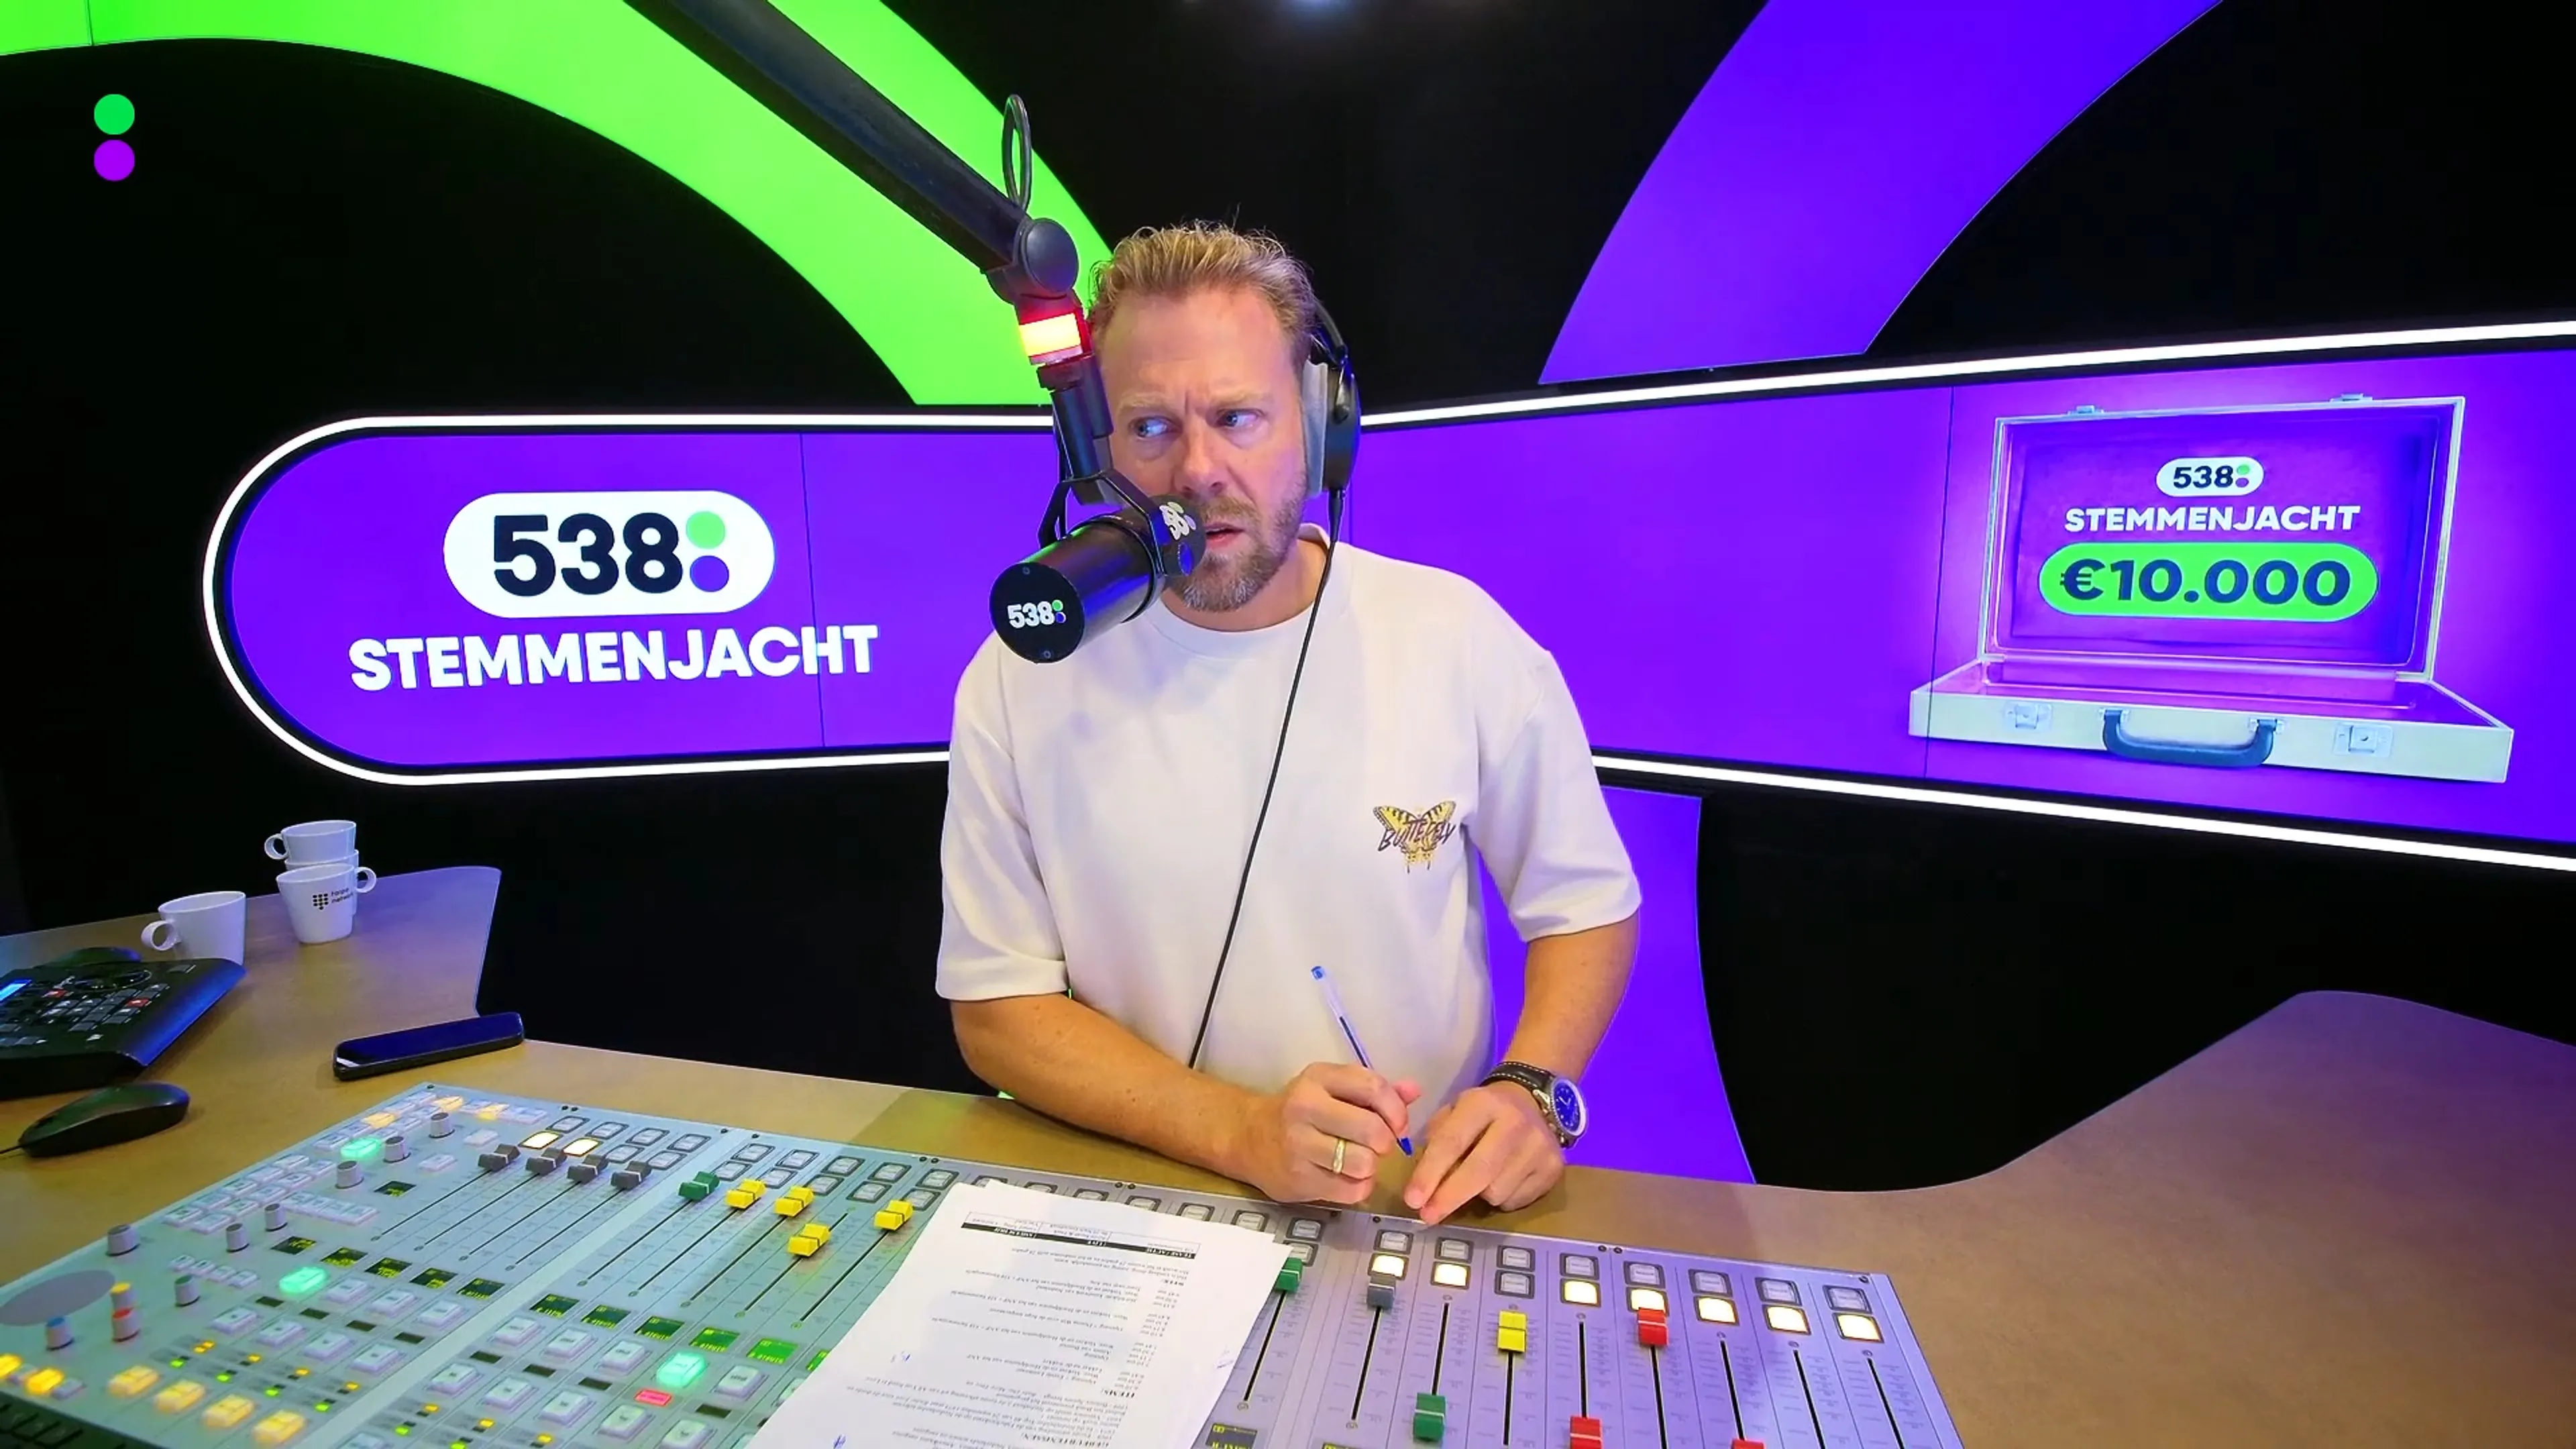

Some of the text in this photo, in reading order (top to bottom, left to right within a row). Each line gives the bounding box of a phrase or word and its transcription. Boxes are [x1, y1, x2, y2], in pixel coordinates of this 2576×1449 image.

[2173, 465, 2234, 488] 538
[2065, 505, 2361, 532] STEMMENJACHT
[494, 513, 682, 596] 538
[2060, 559, 2351, 605] €10.000
[1008, 601, 1055, 629] 538
[348, 625, 879, 691] STEMMENJACHT
